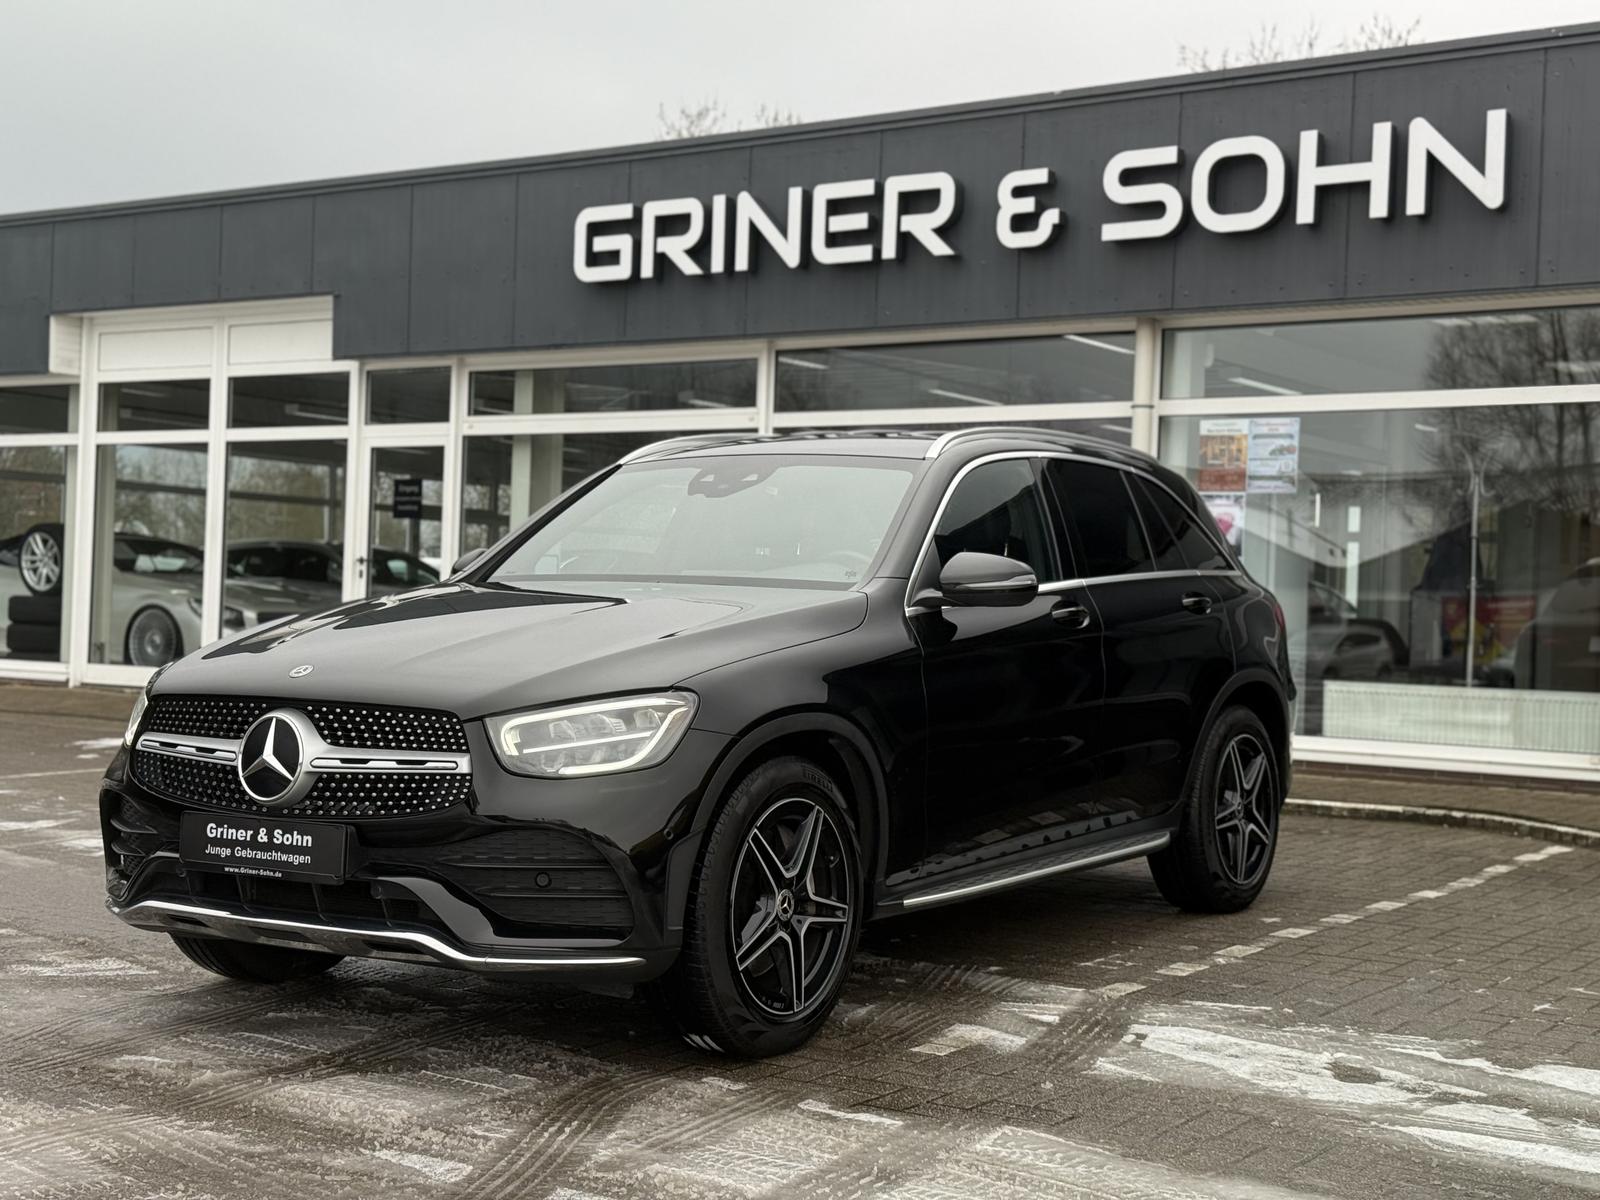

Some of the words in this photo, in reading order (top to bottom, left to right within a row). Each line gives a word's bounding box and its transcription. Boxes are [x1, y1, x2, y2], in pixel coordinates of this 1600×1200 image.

[573, 171, 956, 284] GRINER
[996, 167, 1062, 250] &
[1101, 108, 1508, 242] SOHN
[206, 822, 254, 841] Griner
[257, 828, 268, 843] &
[273, 829, 313, 847] Sohn
[205, 844, 232, 858] Junge
[234, 847, 311, 865] Gebrauchtwagen
[224, 867, 282, 877] www.Griner-Sohn.de
